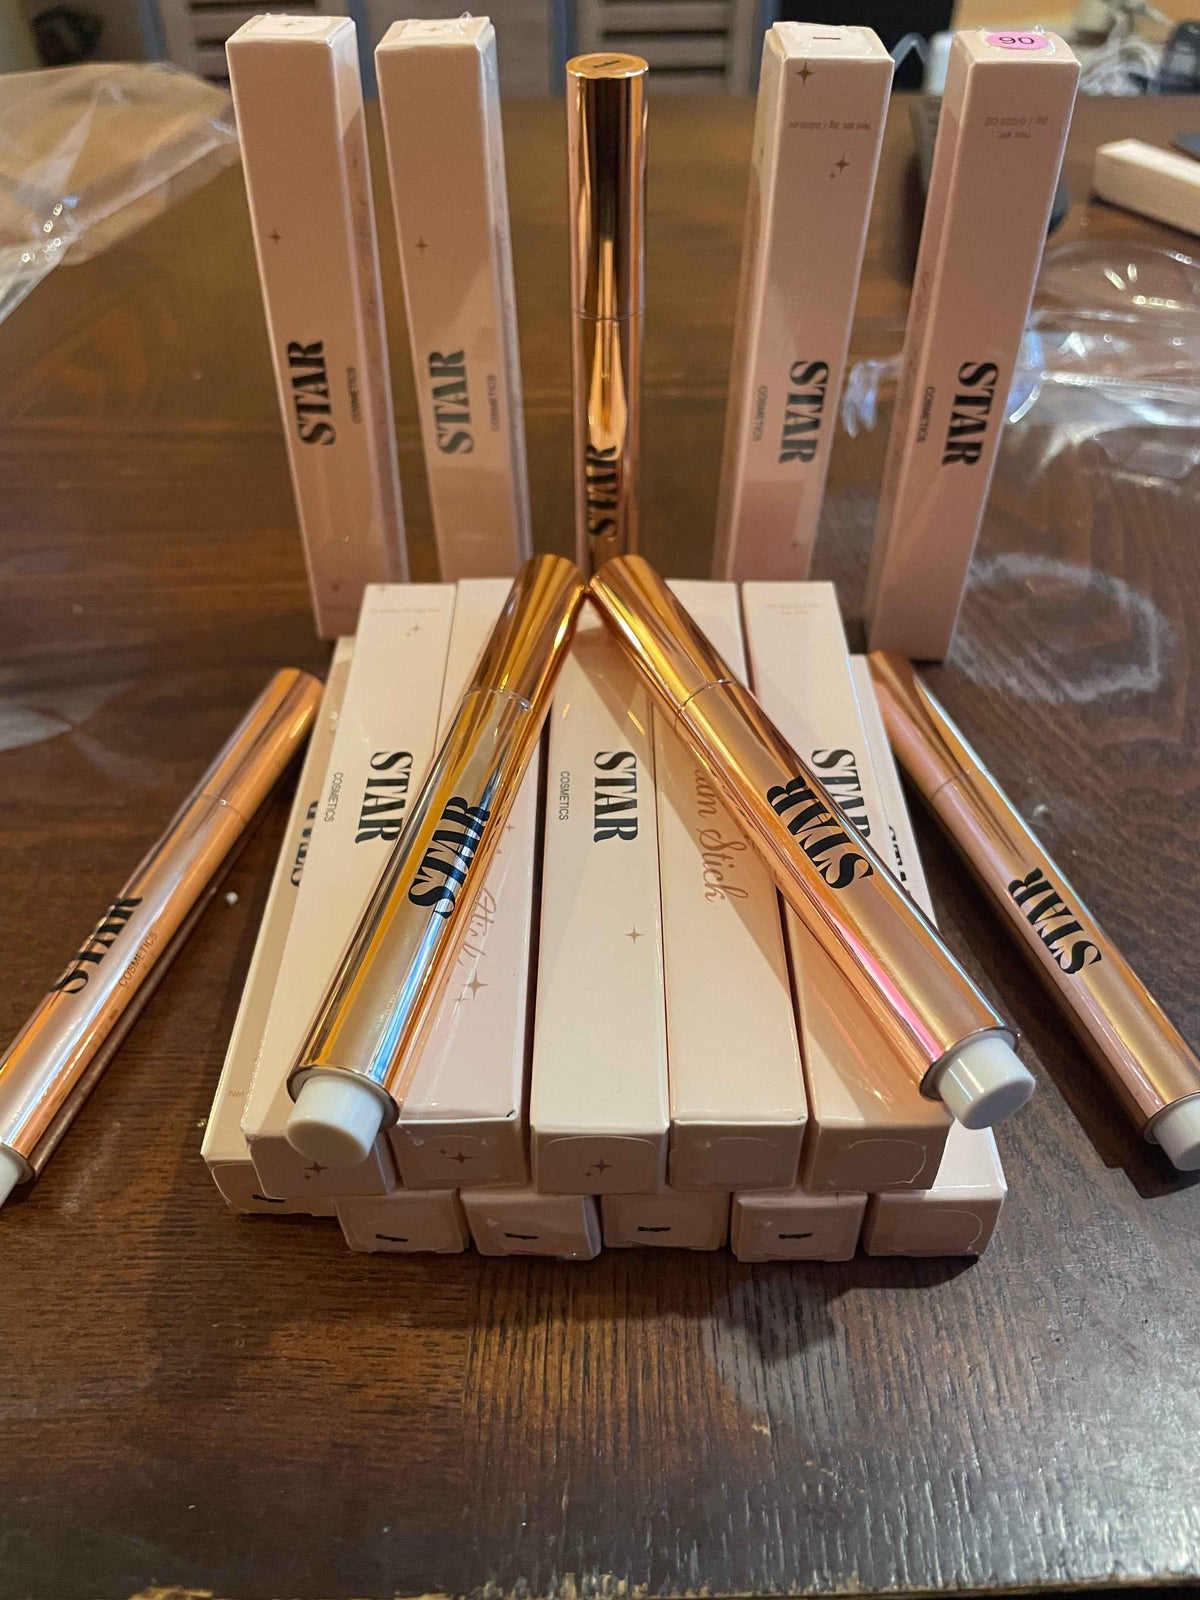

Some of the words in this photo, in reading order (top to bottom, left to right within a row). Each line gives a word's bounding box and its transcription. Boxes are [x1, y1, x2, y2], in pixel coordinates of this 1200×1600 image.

[287, 341, 336, 446] STAR
[346, 367, 361, 423] COSMETICS
[429, 350, 474, 454] STAR
[487, 375, 500, 431] COSMETICS
[752, 386, 767, 441] COSMETICS
[778, 361, 829, 463] STAR
[917, 386, 935, 442] COSMETICS
[940, 362, 998, 466] STAR
[585, 445, 617, 536] STAR
[324, 772, 343, 822] COSMETICS
[355, 751, 413, 844] STAR
[559, 771, 570, 820] COSMETICS
[593, 751, 638, 842] STAR
[766, 775, 874, 889] STAR
[408, 796, 491, 919] STAR
[696, 828, 749, 903] Stick
[119, 932, 158, 987] COSMETICS
[1008, 867, 1102, 974] STAR
